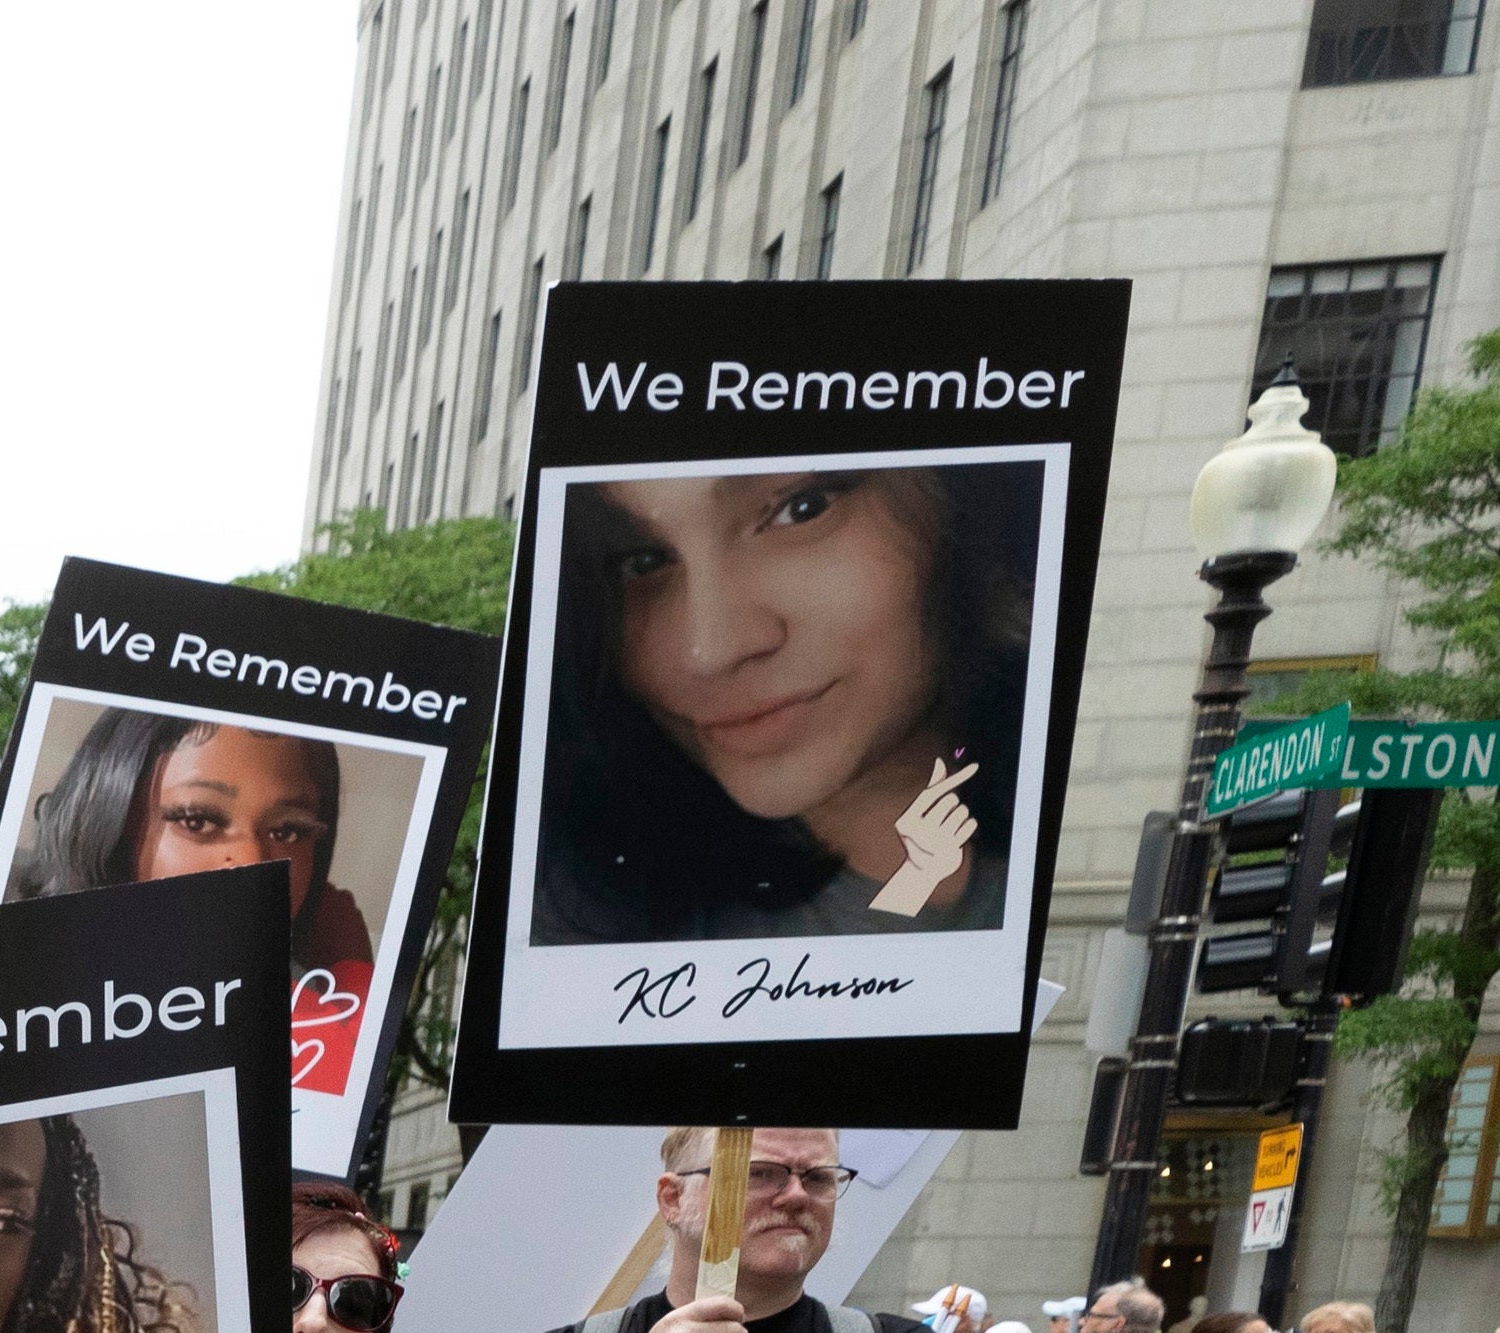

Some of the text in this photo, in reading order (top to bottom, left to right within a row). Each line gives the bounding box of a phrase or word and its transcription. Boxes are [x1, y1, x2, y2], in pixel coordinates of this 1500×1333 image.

[575, 357, 1085, 413] We Remember
[73, 612, 469, 728] We Remember
[1215, 722, 1342, 804] CLARENDON ST
[1341, 733, 1497, 780] LSTON
[614, 951, 915, 1025] KC Johnson
